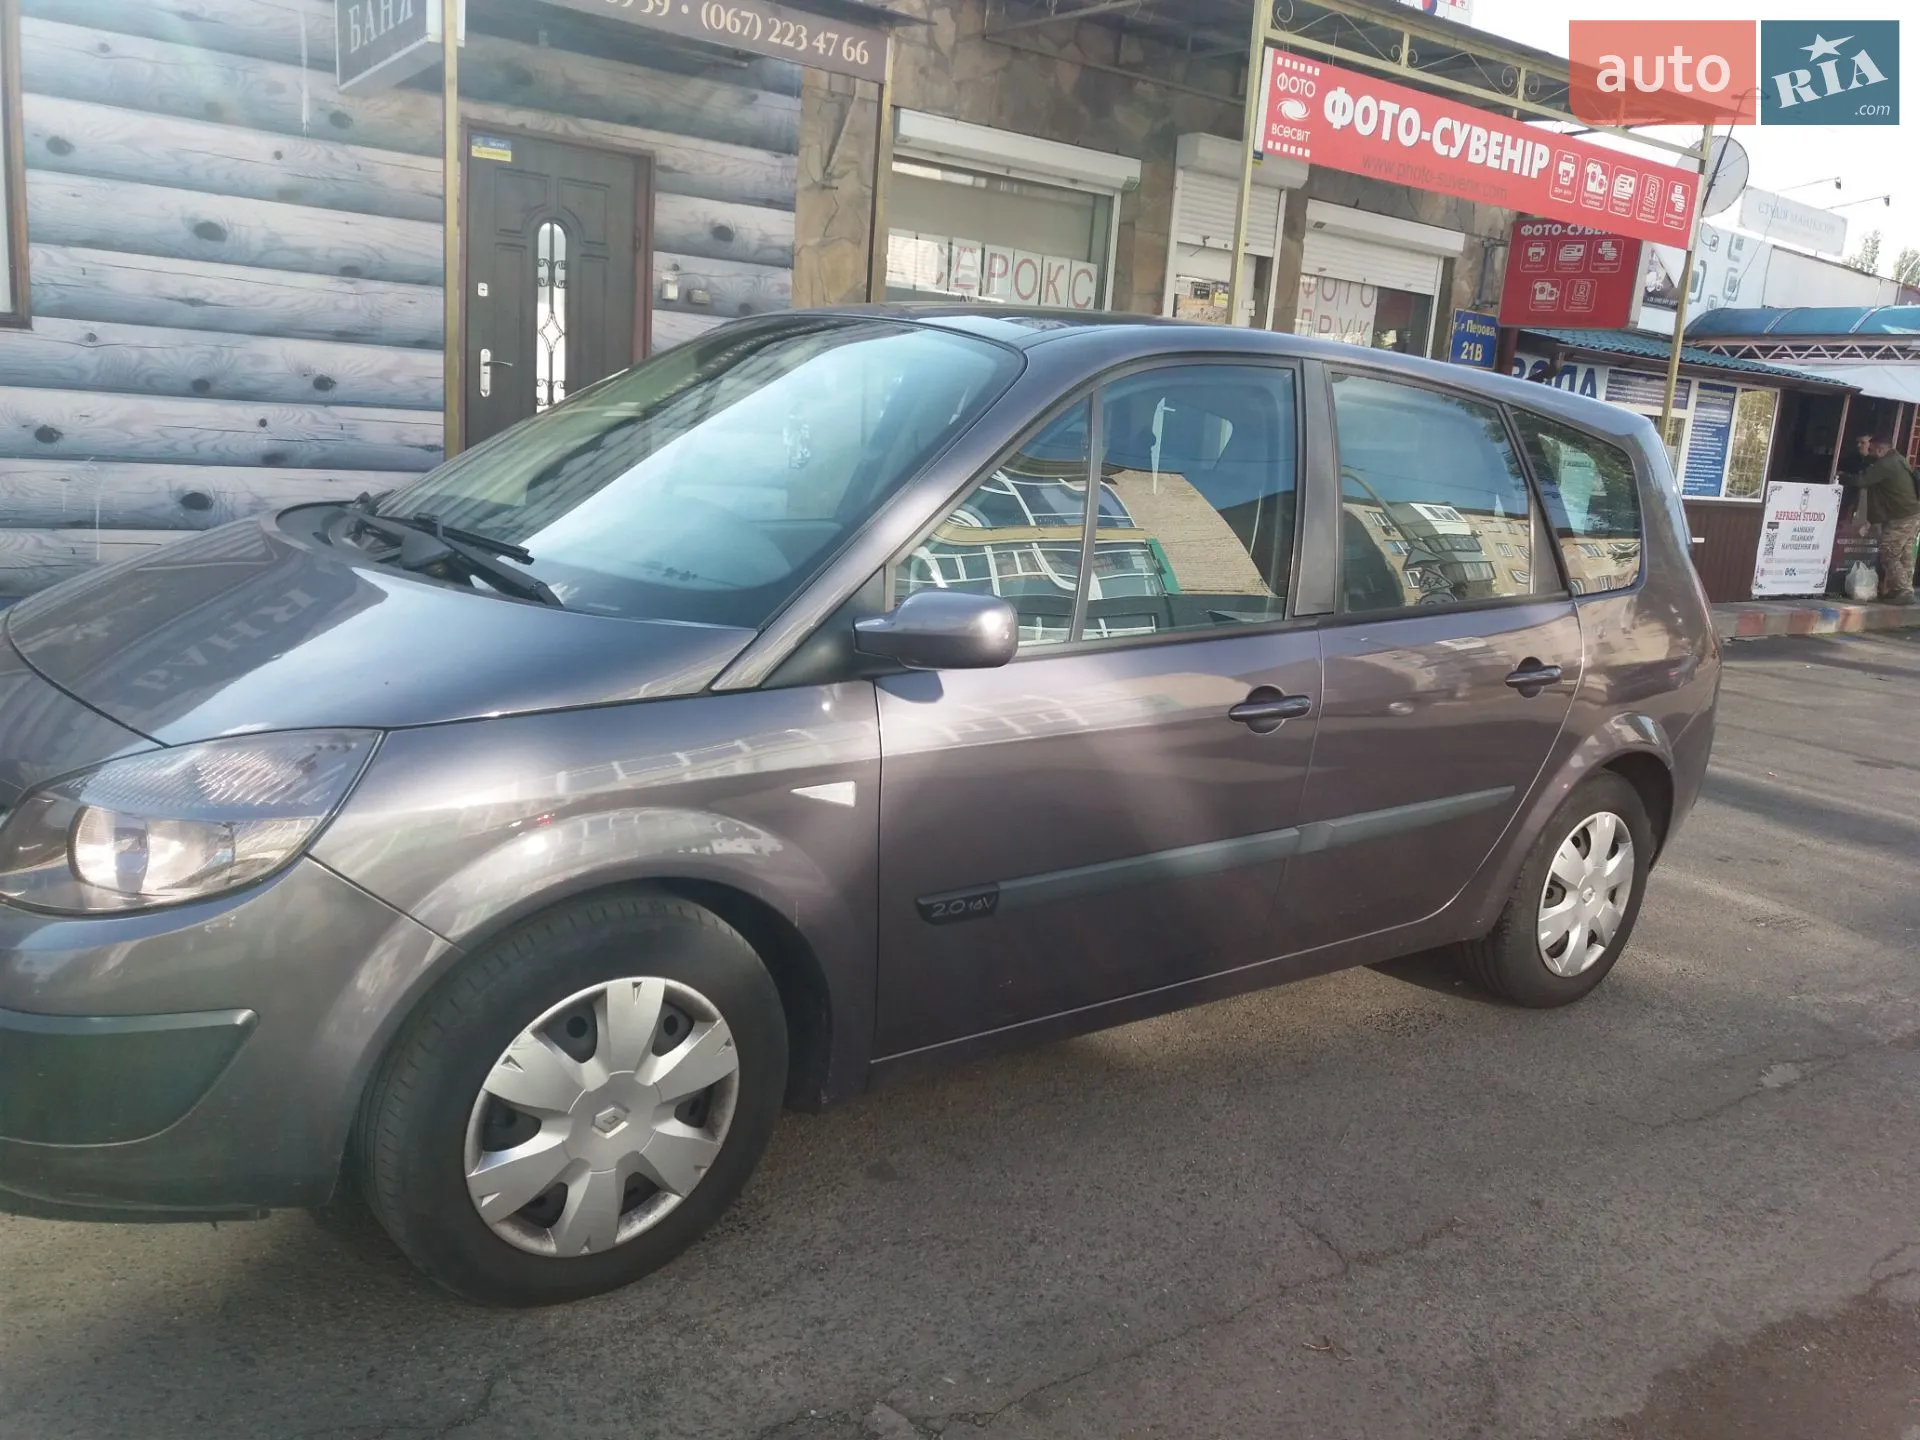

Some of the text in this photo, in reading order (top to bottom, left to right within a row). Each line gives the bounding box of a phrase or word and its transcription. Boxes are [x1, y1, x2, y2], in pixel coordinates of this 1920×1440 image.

[700, 2, 762, 41] (067)
[768, 17, 808, 51] 223
[811, 31, 839, 57] 47
[842, 35, 870, 66] 66
[1276, 71, 1316, 98] ФОТО
[1323, 86, 1550, 179] ФОТО-СУВЕНІР
[892, 240, 1094, 309] ЕРОКС
[1460, 340, 1483, 362] 21В
[1775, 510, 1826, 522] REFRESH STUDIO
[931, 899, 966, 918] 2.0
